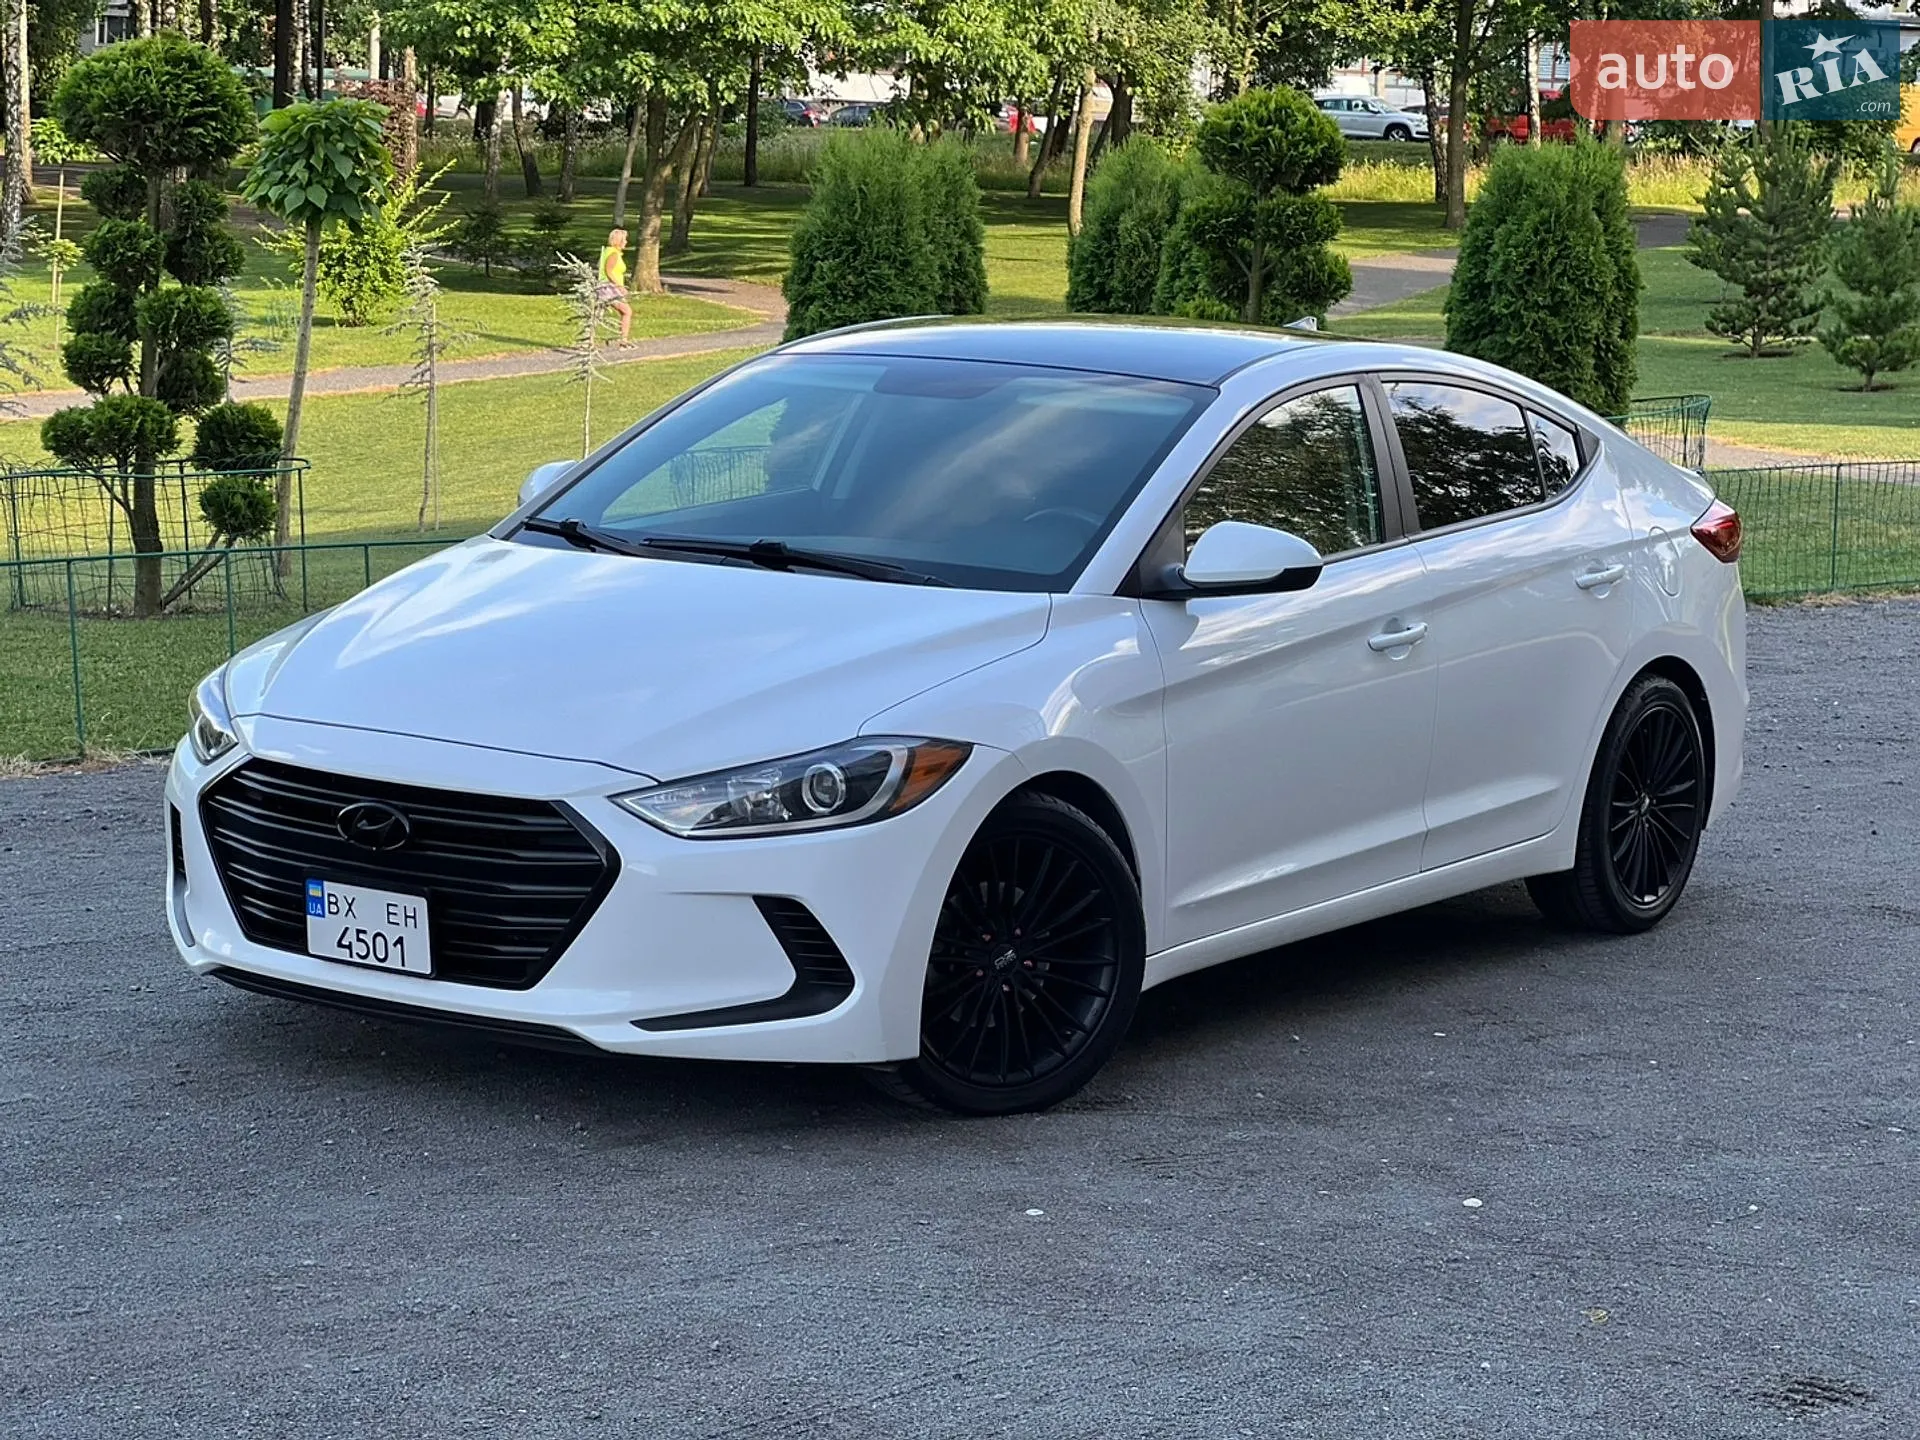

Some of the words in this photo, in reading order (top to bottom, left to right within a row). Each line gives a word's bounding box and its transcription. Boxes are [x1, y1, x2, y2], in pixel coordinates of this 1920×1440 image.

[308, 902, 323, 916] UA
[327, 893, 356, 919] BX
[386, 902, 417, 929] EH
[336, 926, 406, 967] 4501
